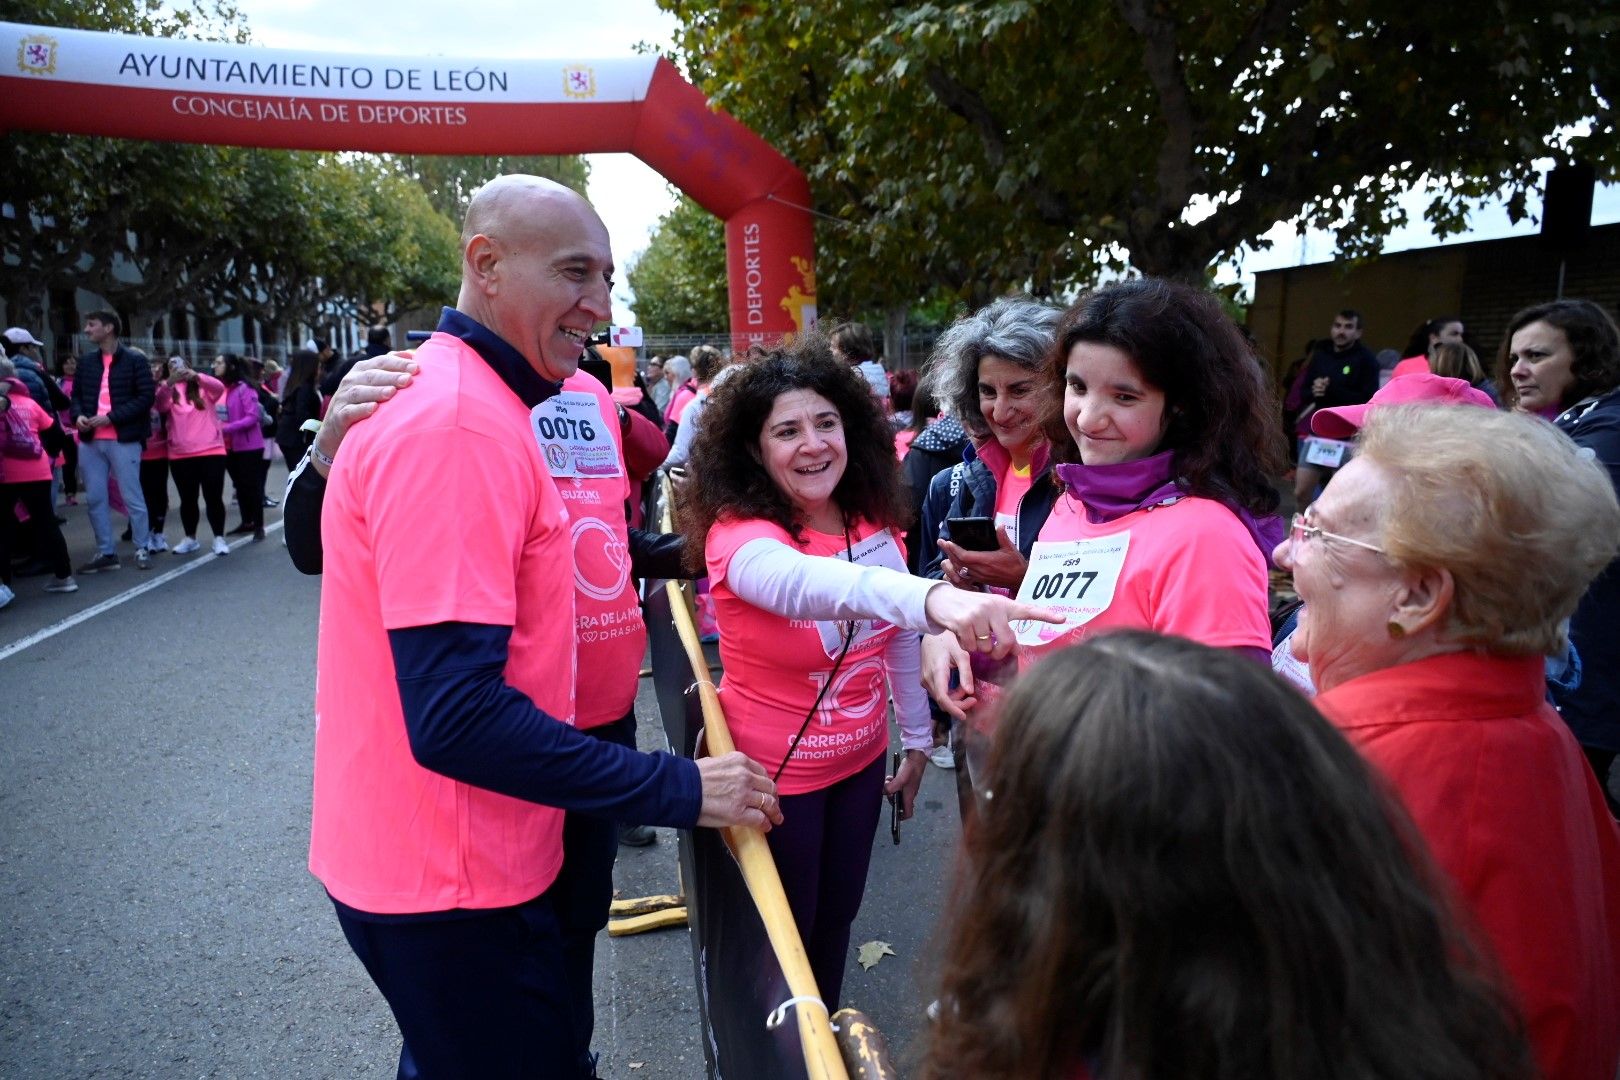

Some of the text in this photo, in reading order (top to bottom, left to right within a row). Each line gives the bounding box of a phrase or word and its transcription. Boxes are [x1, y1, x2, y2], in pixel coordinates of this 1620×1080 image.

[119, 52, 508, 92] AYUNTAMIENTO DE LEÓN
[172, 96, 467, 125] CONCEJALÍA DE DEPORTES
[744, 223, 763, 325] DEPORTES
[538, 416, 596, 442] 0076
[562, 490, 600, 500] SUZUKI
[1032, 571, 1098, 600] 0077
[600, 612, 615, 626] DE
[616, 611, 627, 624] LA
[787, 733, 854, 749] CARRERA
[855, 728, 869, 741] DE
